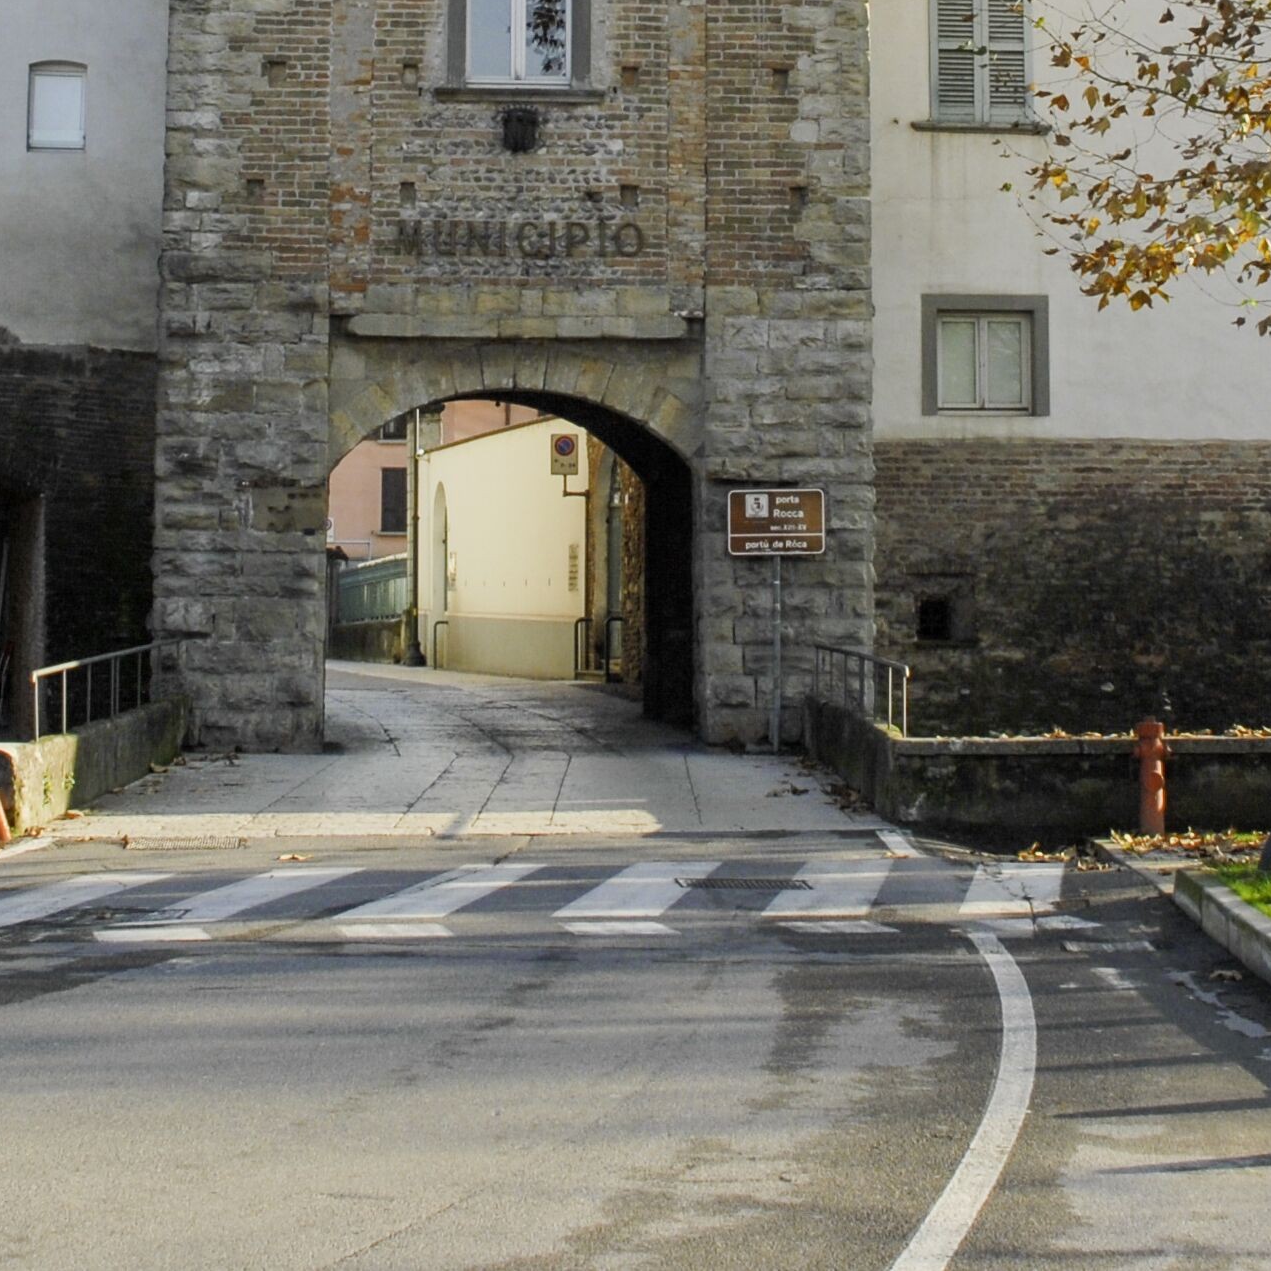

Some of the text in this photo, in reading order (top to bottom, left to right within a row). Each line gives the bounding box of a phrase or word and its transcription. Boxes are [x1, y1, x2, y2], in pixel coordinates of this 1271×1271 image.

[397, 219, 644, 258] MUNICIPIO
[775, 495, 800, 505] porta
[773, 509, 804, 518] Rocca
[772, 540, 784, 548] de
